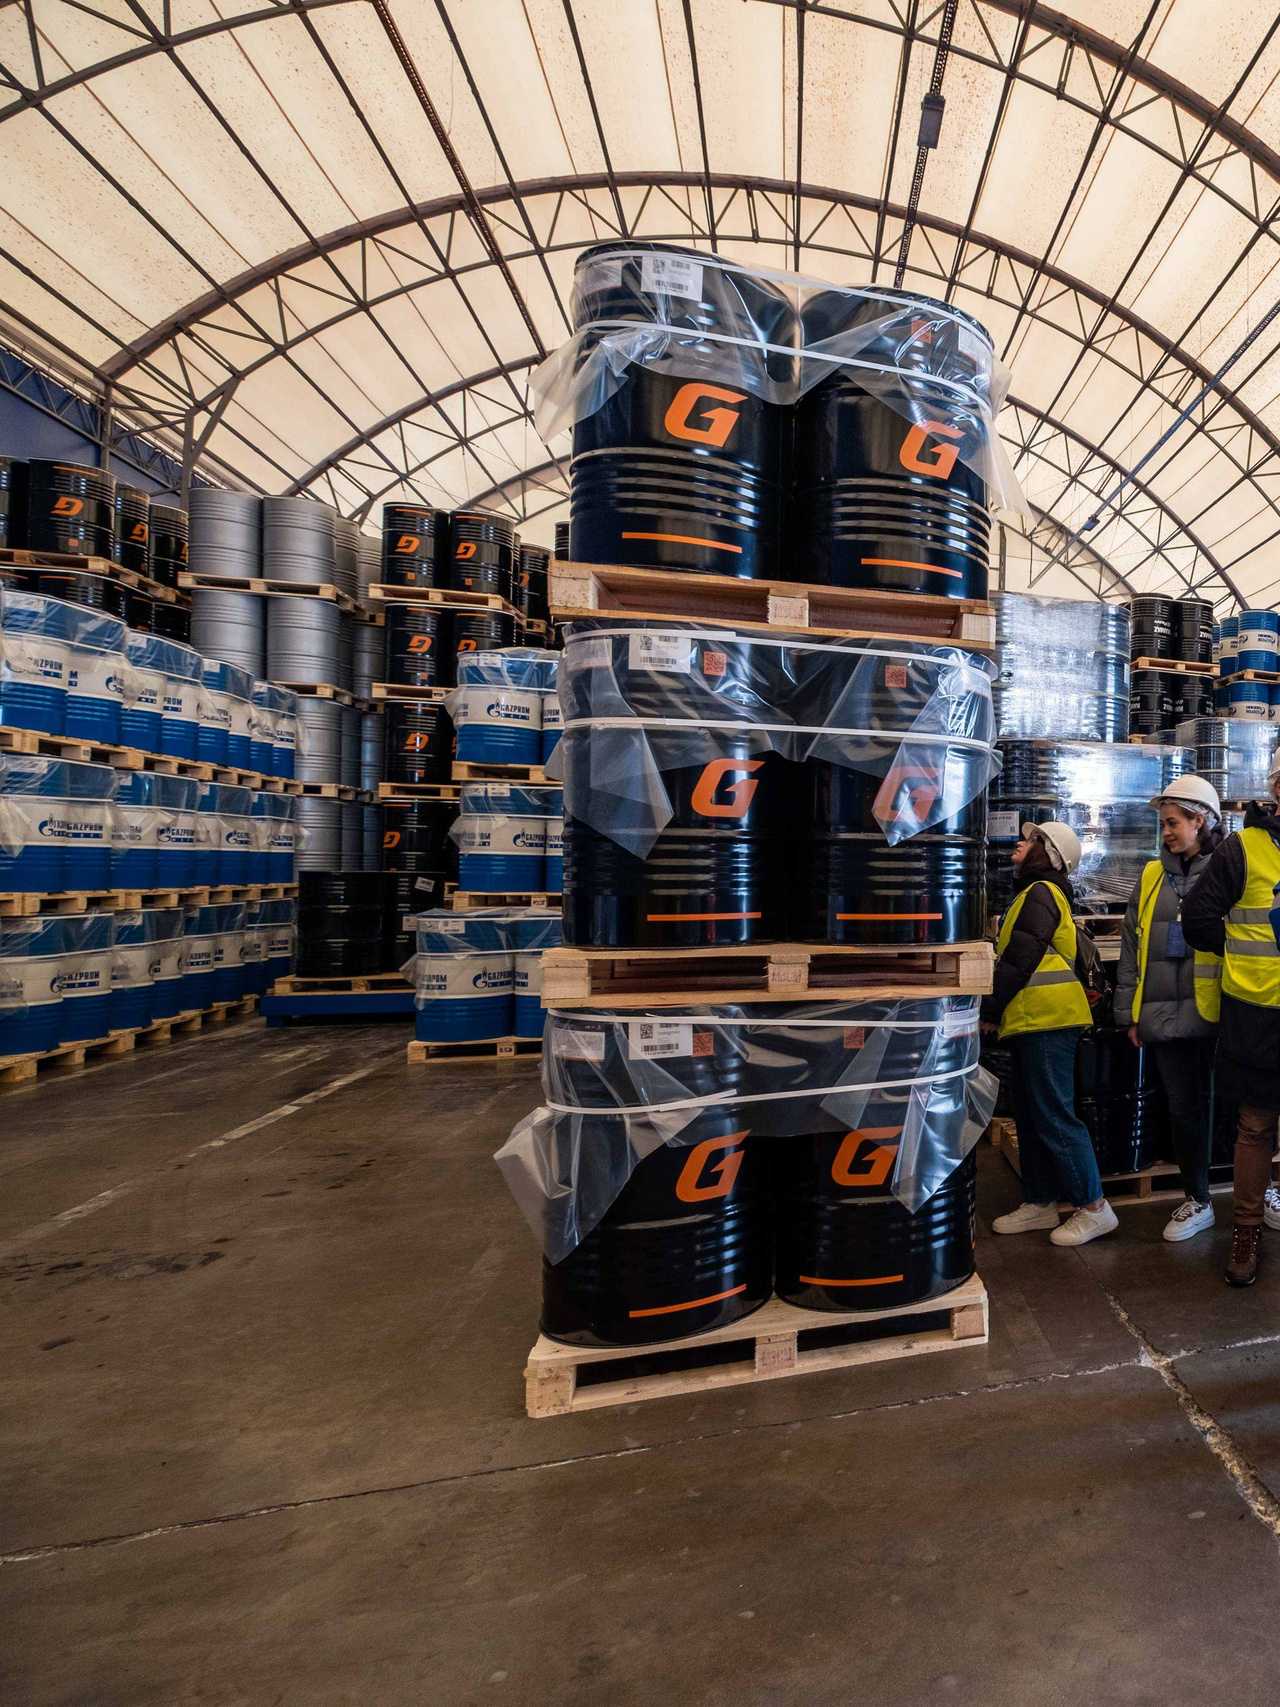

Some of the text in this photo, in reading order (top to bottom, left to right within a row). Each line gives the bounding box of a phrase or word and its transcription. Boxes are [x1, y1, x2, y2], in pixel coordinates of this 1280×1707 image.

[664, 382, 748, 447] G
[900, 420, 966, 480] G
[163, 697, 182, 706] PROM
[501, 704, 530, 714] GAZPROM
[691, 758, 766, 818] G
[872, 765, 945, 823] G
[675, 1129, 751, 1203] G
[831, 1125, 904, 1186] G
